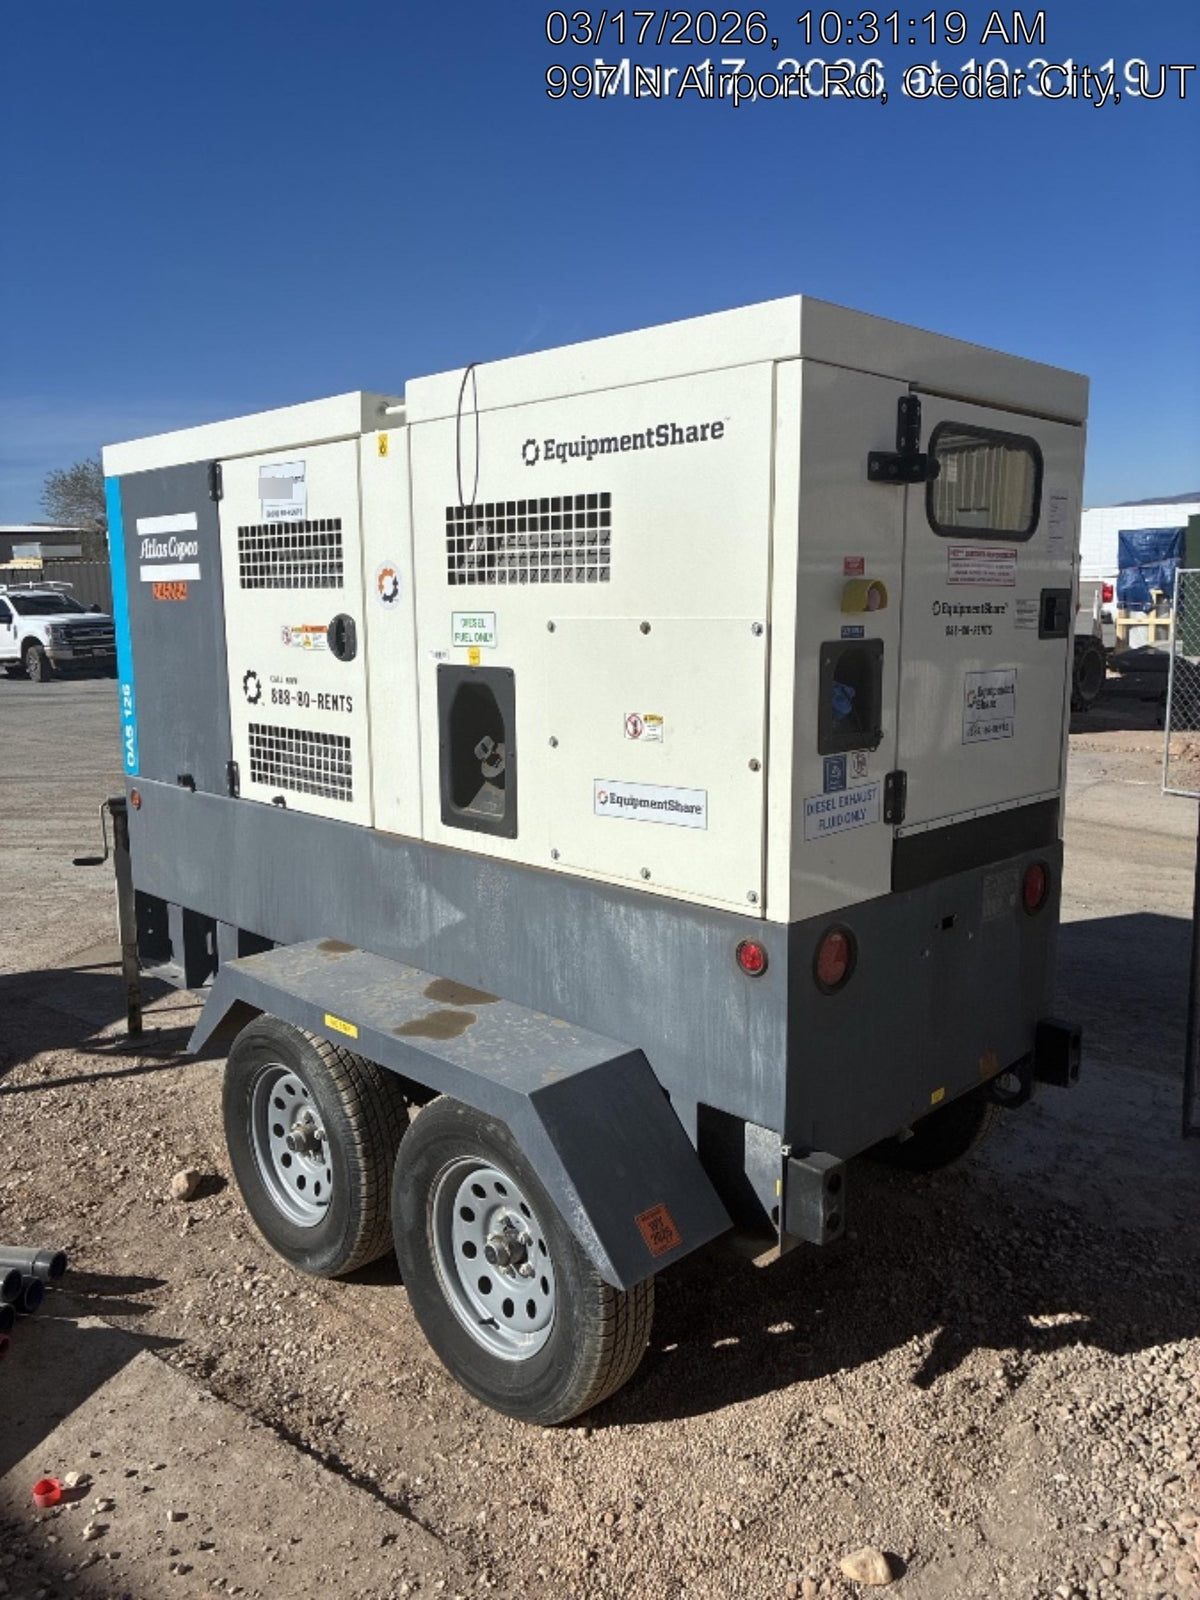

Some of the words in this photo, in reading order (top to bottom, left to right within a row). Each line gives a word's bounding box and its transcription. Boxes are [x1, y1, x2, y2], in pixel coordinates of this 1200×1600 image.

[543, 420, 724, 463] EquipmentShare
[140, 538, 168, 559] Atlas
[168, 536, 198, 561] Copco
[942, 602, 1006, 617] EquipmentShare
[461, 618, 486, 628] DIESEL
[455, 632, 473, 642] FUEL
[271, 688, 353, 713] 888-80-RENTS
[609, 792, 702, 814] EquipmentShare
[807, 798, 836, 816] DIESEL
[839, 787, 877, 807] EXHAUST
